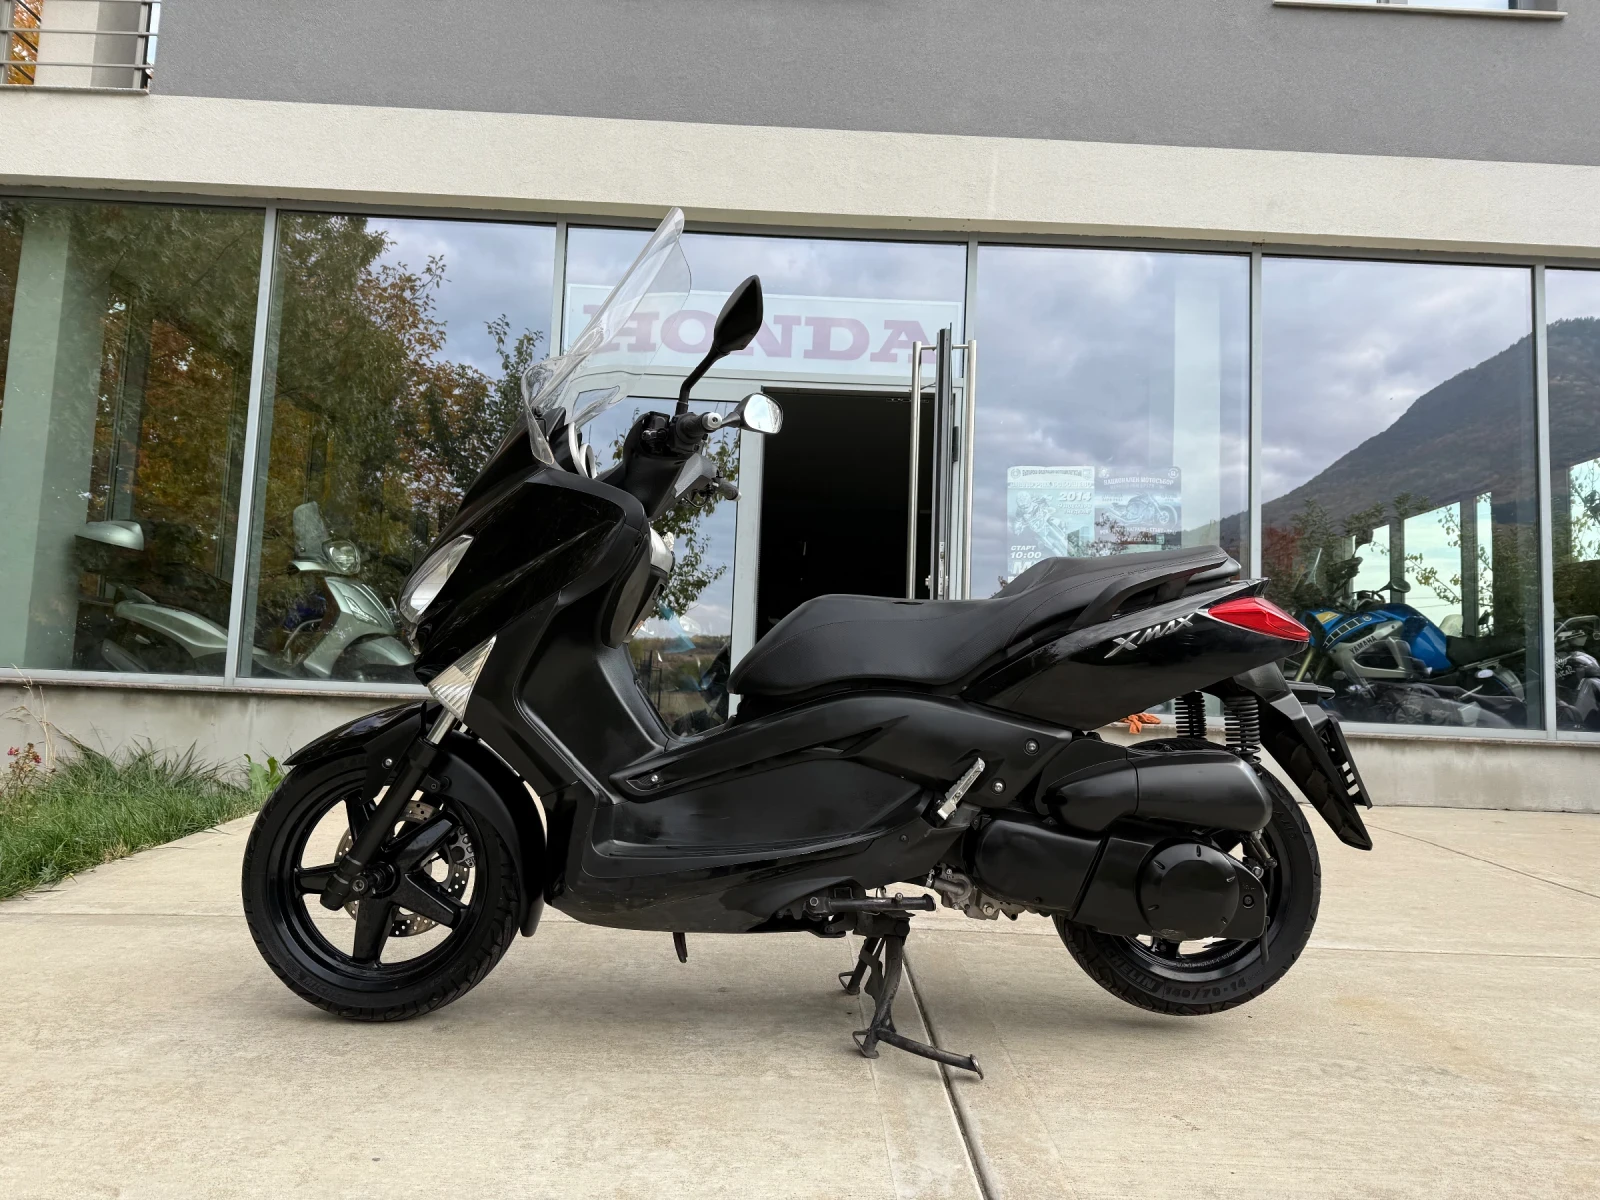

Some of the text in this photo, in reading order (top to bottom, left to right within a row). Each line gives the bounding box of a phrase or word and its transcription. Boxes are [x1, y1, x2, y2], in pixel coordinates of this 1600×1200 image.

[583, 303, 938, 364] HONDA
[1059, 491, 1092, 502] 2014
[1010, 551, 1042, 559] 10:00
[1349, 635, 1378, 655] YAMAHA
